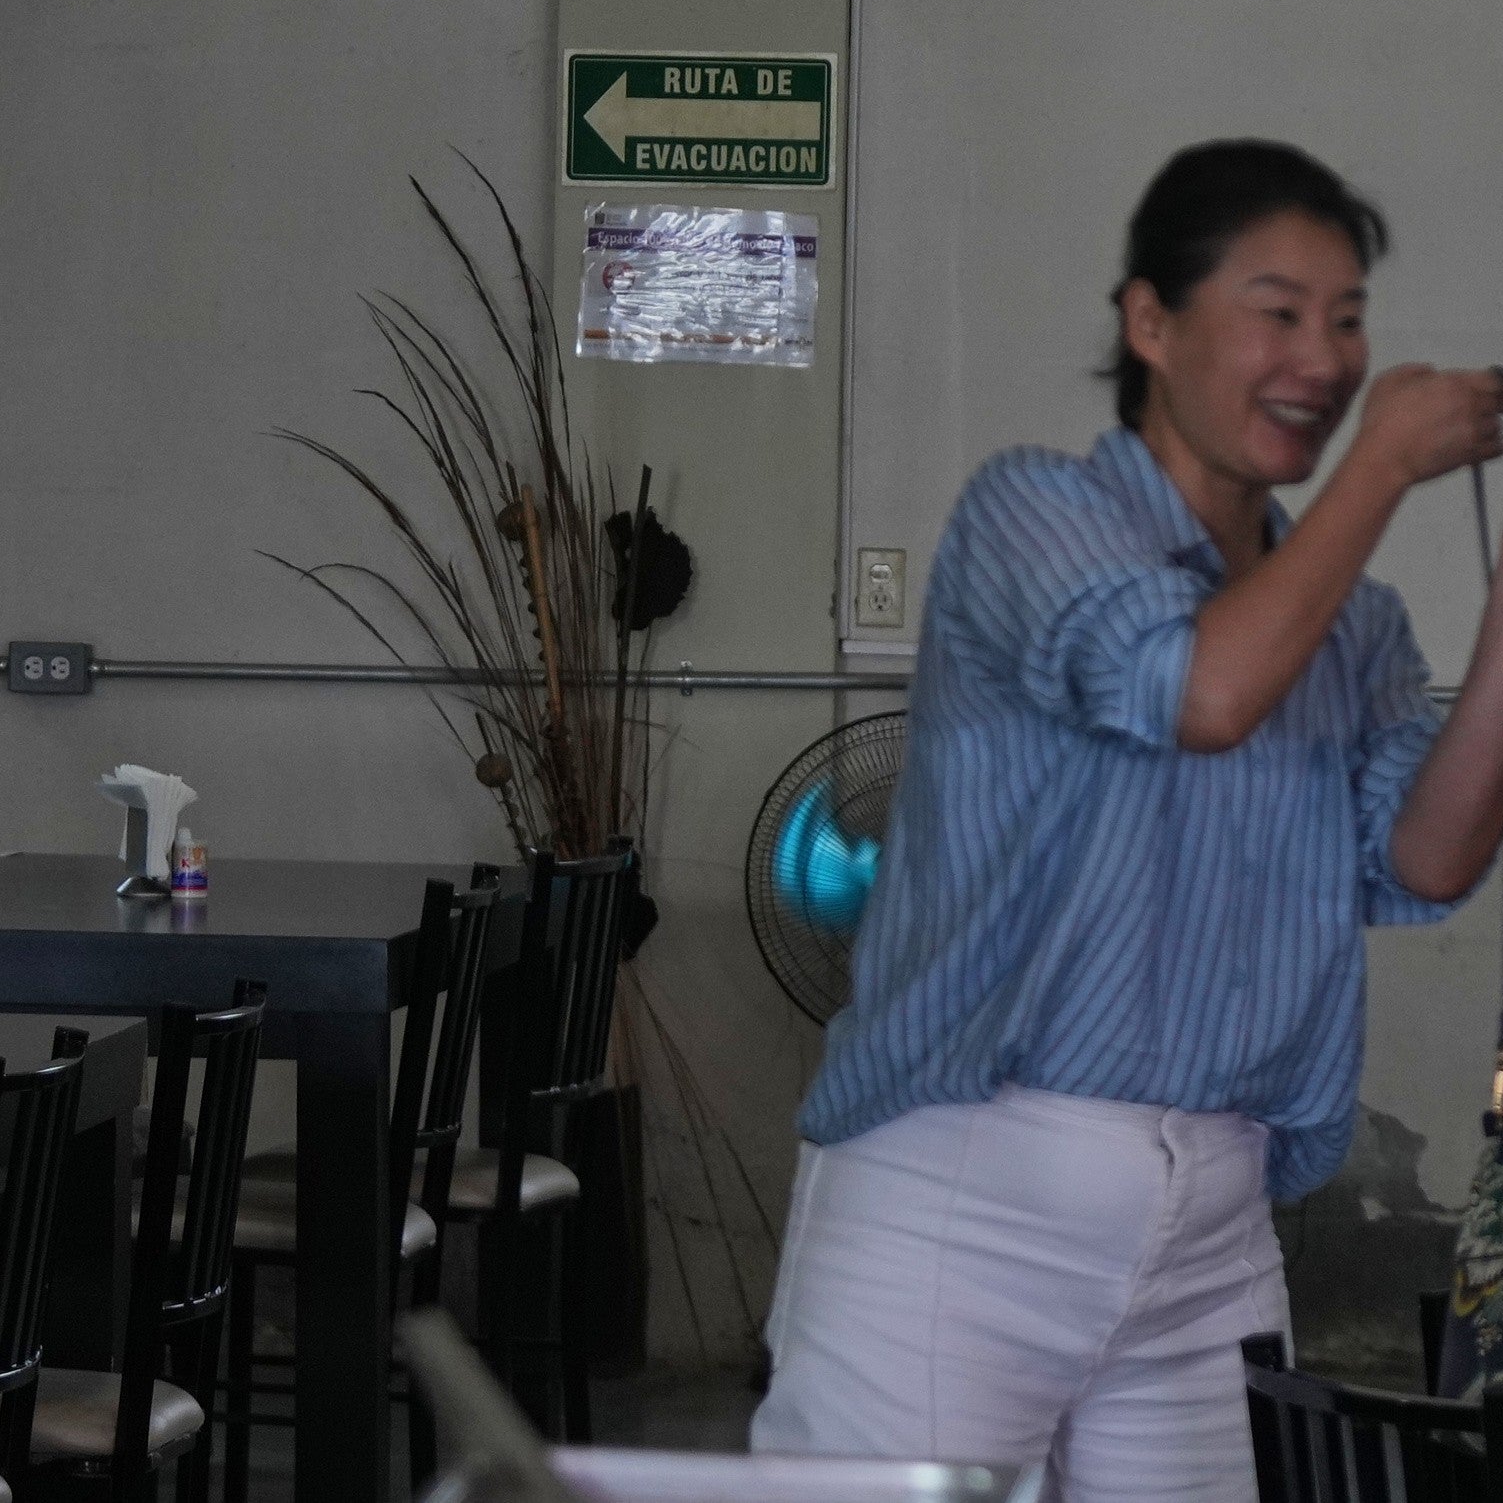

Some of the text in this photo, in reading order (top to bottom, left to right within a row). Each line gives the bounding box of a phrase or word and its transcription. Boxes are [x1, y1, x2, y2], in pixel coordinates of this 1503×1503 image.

[664, 67, 792, 96] RUTA DE
[635, 143, 817, 173] EVACUACION
